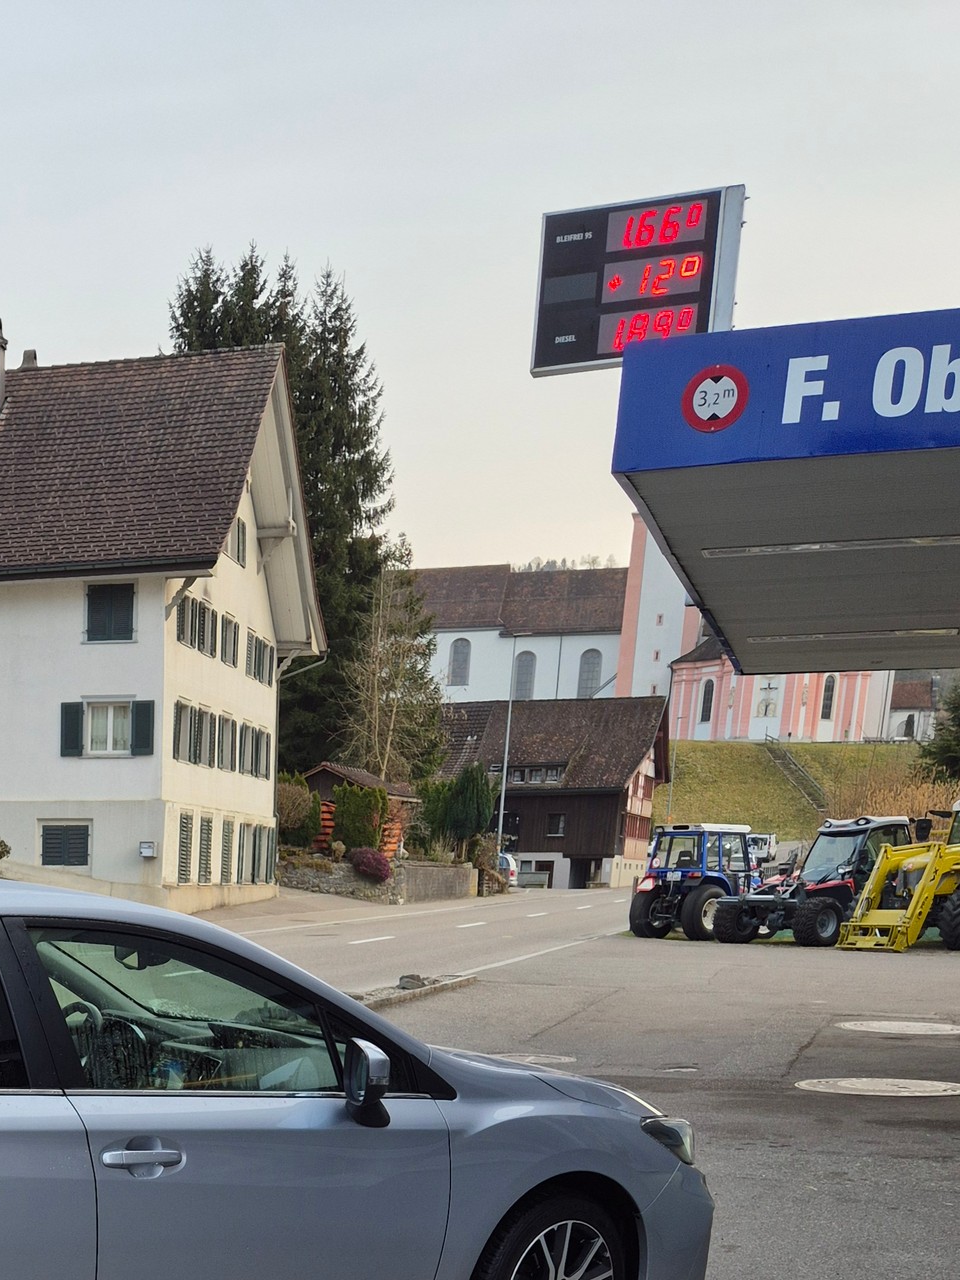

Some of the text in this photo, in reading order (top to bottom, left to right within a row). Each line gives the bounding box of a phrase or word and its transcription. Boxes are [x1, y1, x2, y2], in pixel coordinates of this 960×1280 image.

[555, 231, 593, 243] BLEIFREI 95
[554, 334, 577, 344] DIESEL
[781, 344, 960, 424] F. Ob
